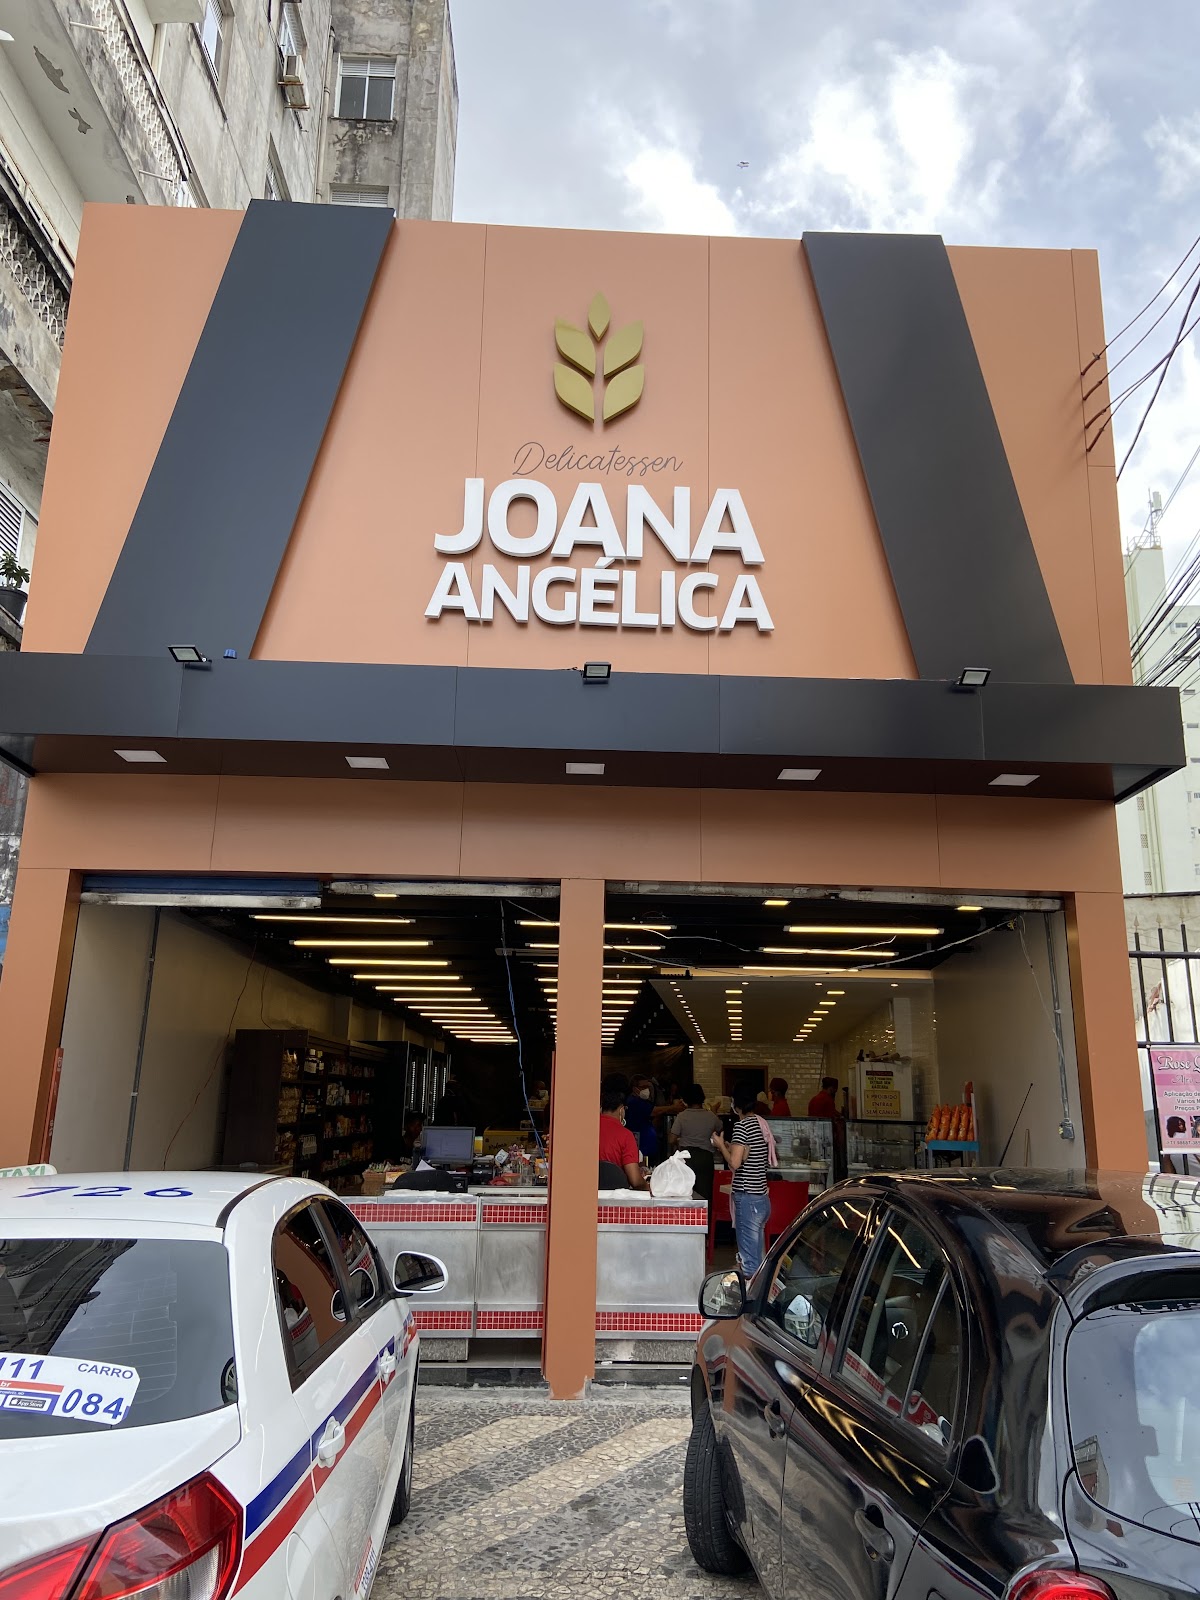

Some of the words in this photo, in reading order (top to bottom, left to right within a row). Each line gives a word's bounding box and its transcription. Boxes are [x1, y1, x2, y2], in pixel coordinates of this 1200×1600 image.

[512, 441, 684, 477] Delicatessen
[433, 477, 765, 565] JOANA
[424, 557, 775, 632] ANGÉLICA
[1157, 1055, 1191, 1070] Rose
[77, 1363, 134, 1380] CARRO
[61, 1388, 125, 1420] 084
